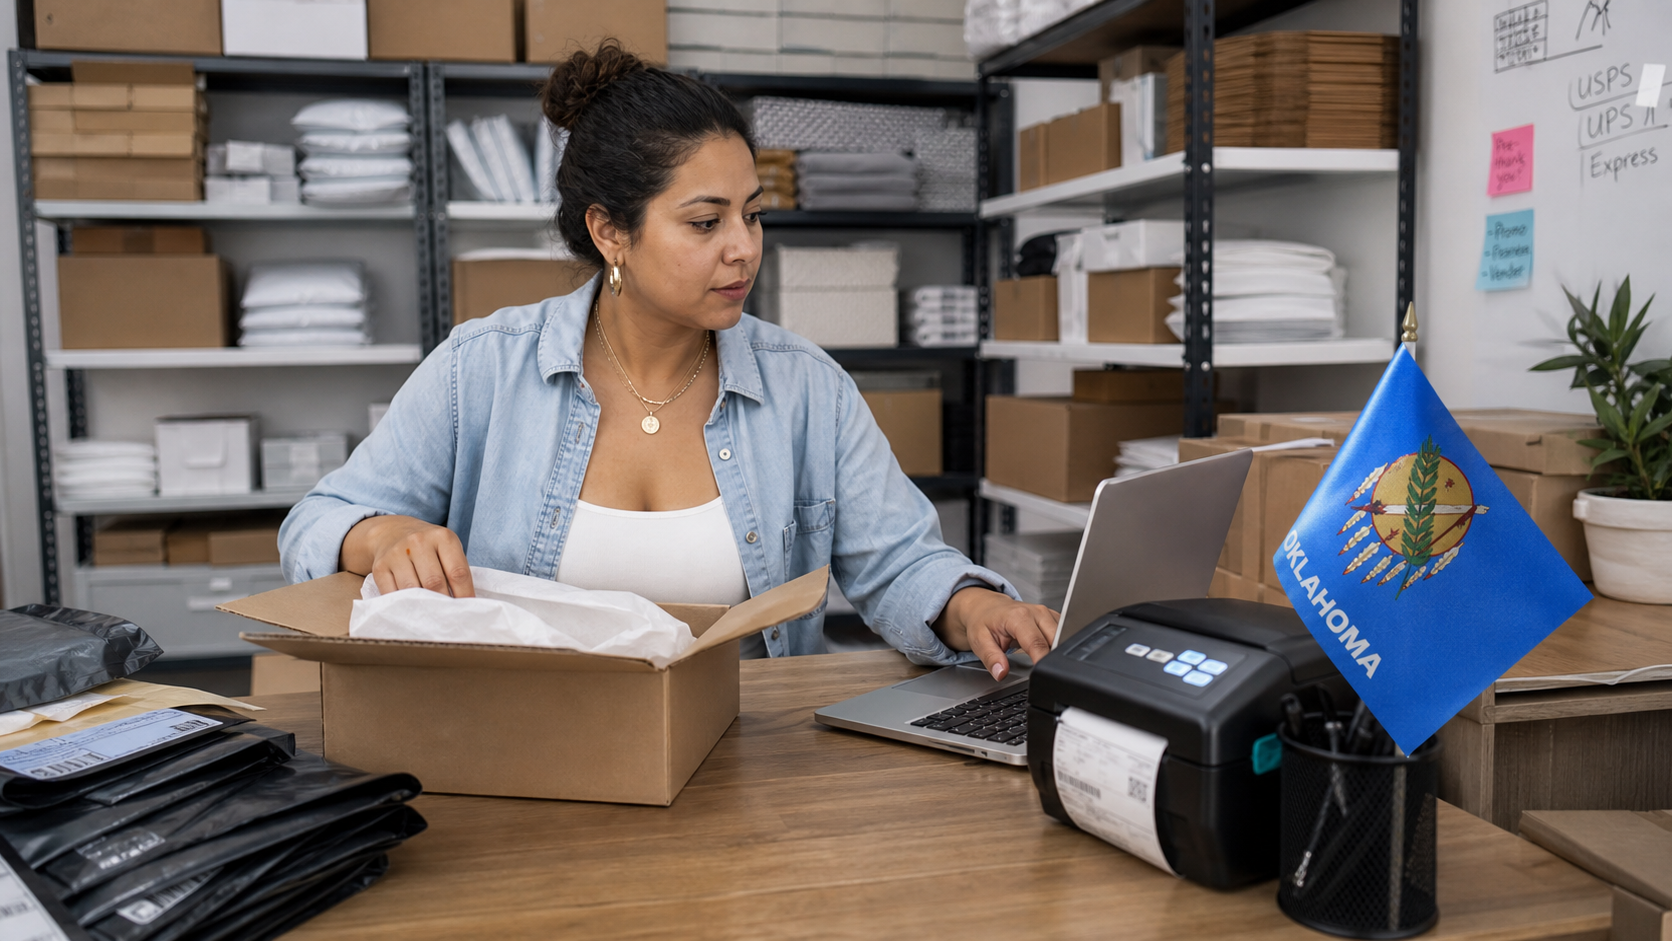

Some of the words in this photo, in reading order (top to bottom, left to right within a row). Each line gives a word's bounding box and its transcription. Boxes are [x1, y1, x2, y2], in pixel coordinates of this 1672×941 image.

[1577, 62, 1633, 100] USPS
[1587, 103, 1634, 139] UPS
[1590, 146, 1659, 183] Express
[1283, 529, 1382, 680] OKLAHOMA
